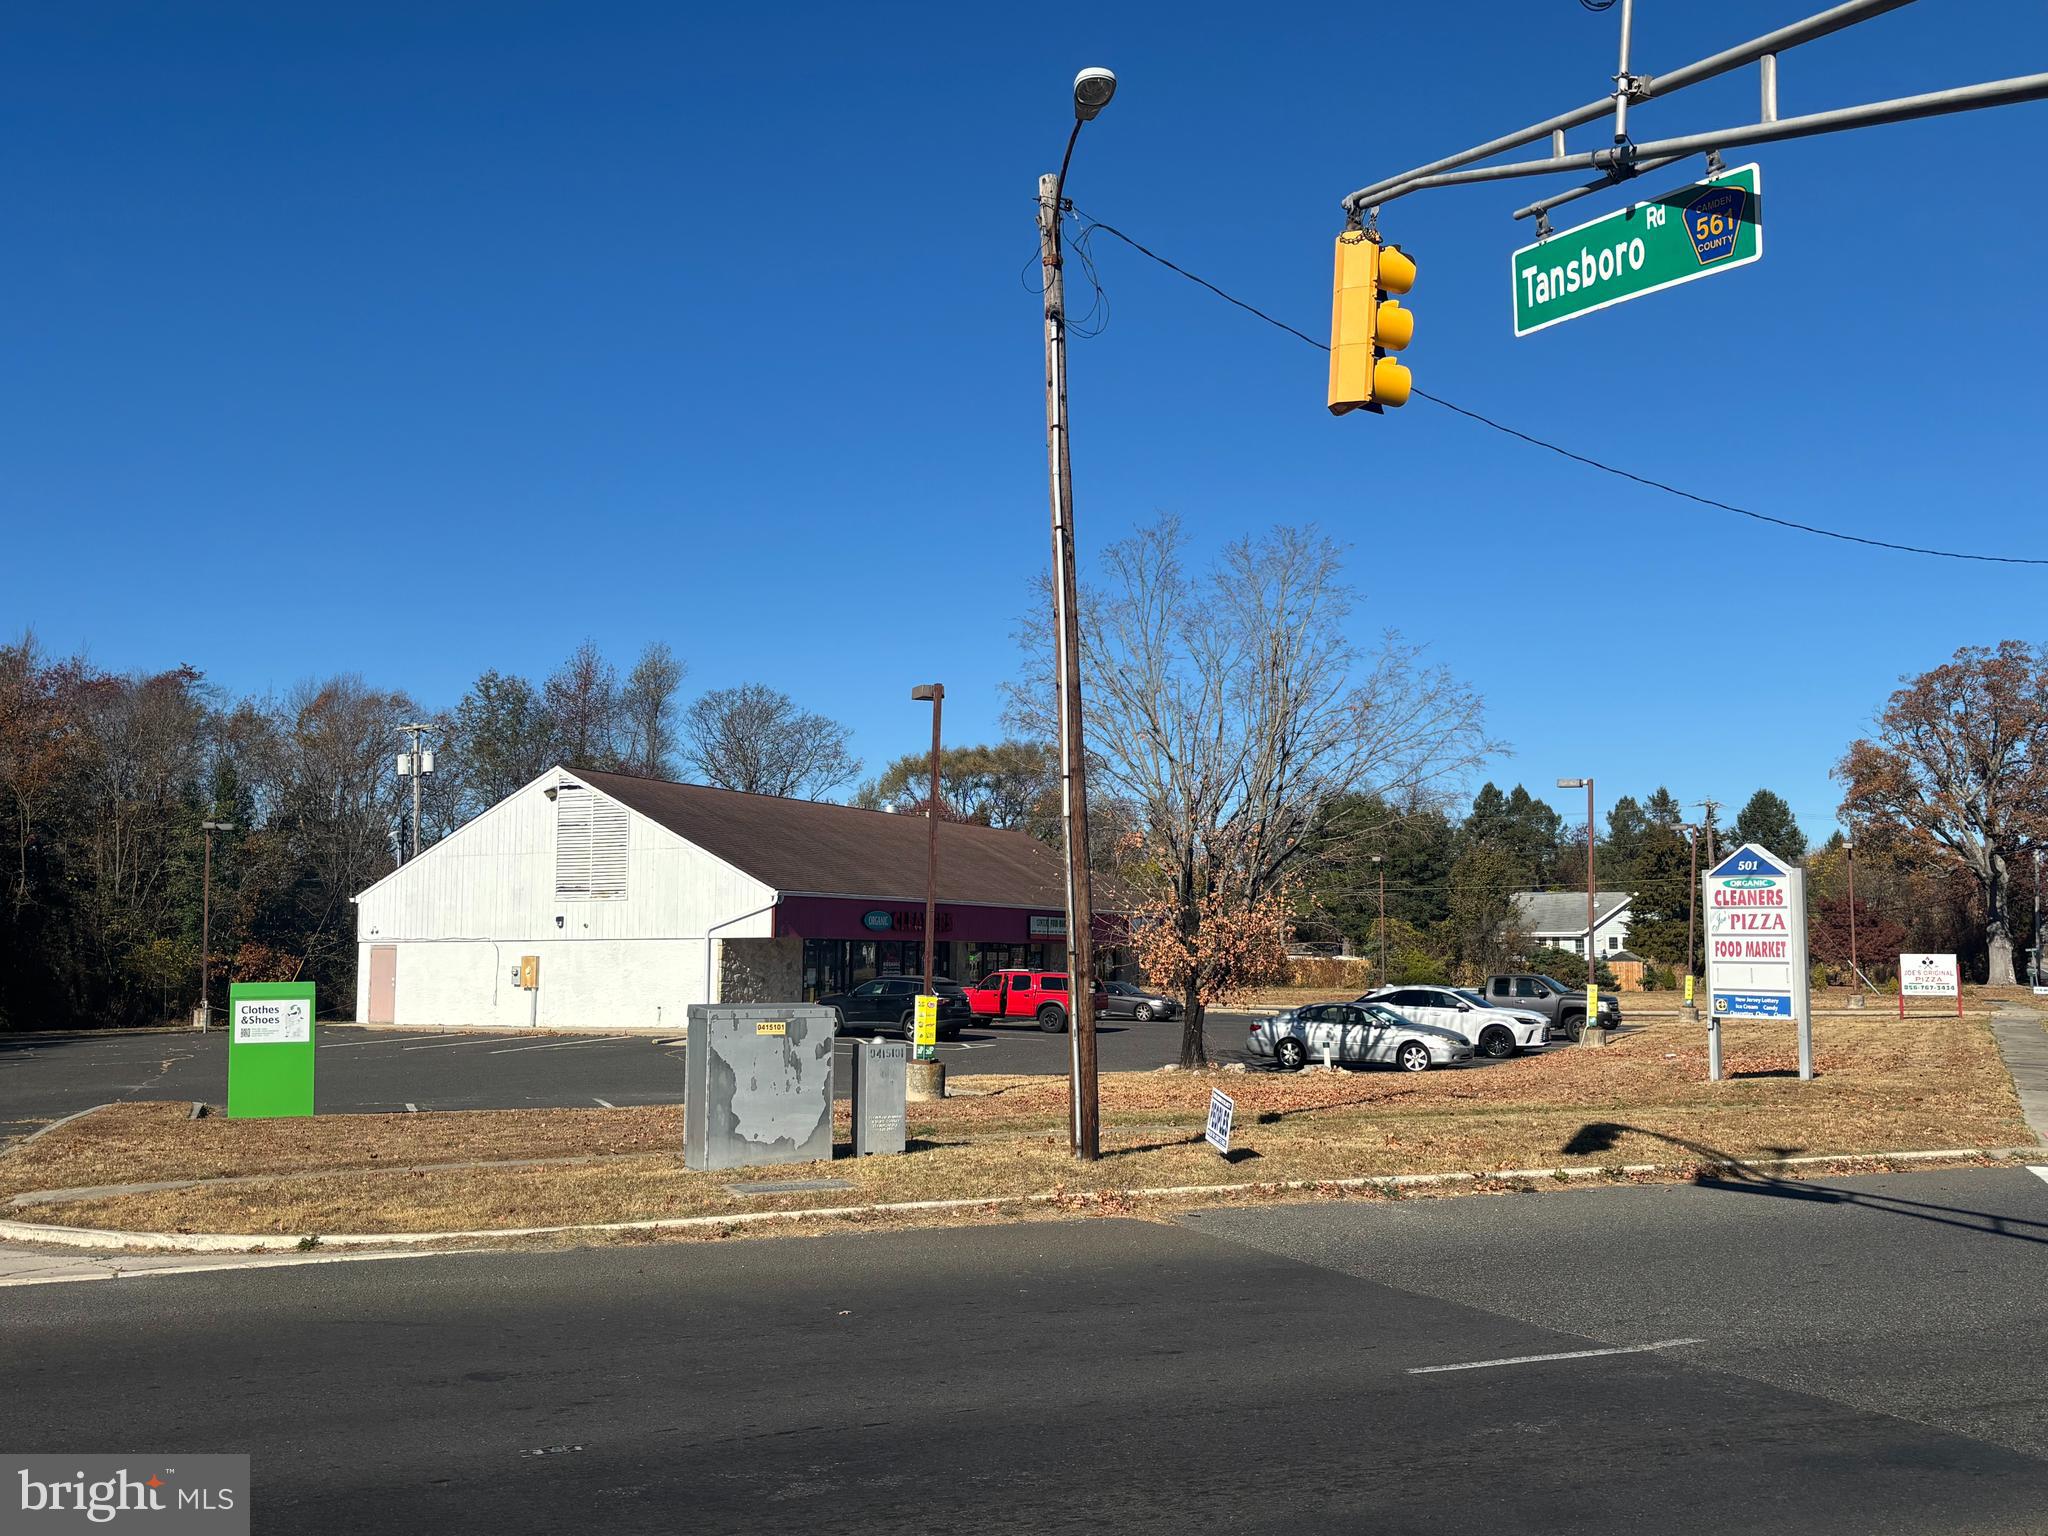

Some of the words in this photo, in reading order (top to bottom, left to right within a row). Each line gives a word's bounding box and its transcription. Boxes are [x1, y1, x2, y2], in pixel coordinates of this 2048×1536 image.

[1696, 195, 1732, 214] CAMDEN
[1646, 203, 1666, 230] Rd
[1696, 208, 1734, 240] 561
[1697, 234, 1733, 253] COUNTY
[1522, 237, 1645, 308] Tansboro
[1738, 860, 1758, 870] 501
[1714, 889, 1783, 906] CLEANERS
[868, 915, 889, 926] ORGANIC
[1730, 913, 1786, 930] PIZZA
[1715, 940, 1742, 957] FOOD
[1746, 940, 1786, 958] MARKET
[241, 1005, 279, 1014] Clothes
[1763, 1004, 1778, 1012] Candy
[241, 1015, 280, 1024] &Shoes
[870, 1048, 904, 1059] 0415101
